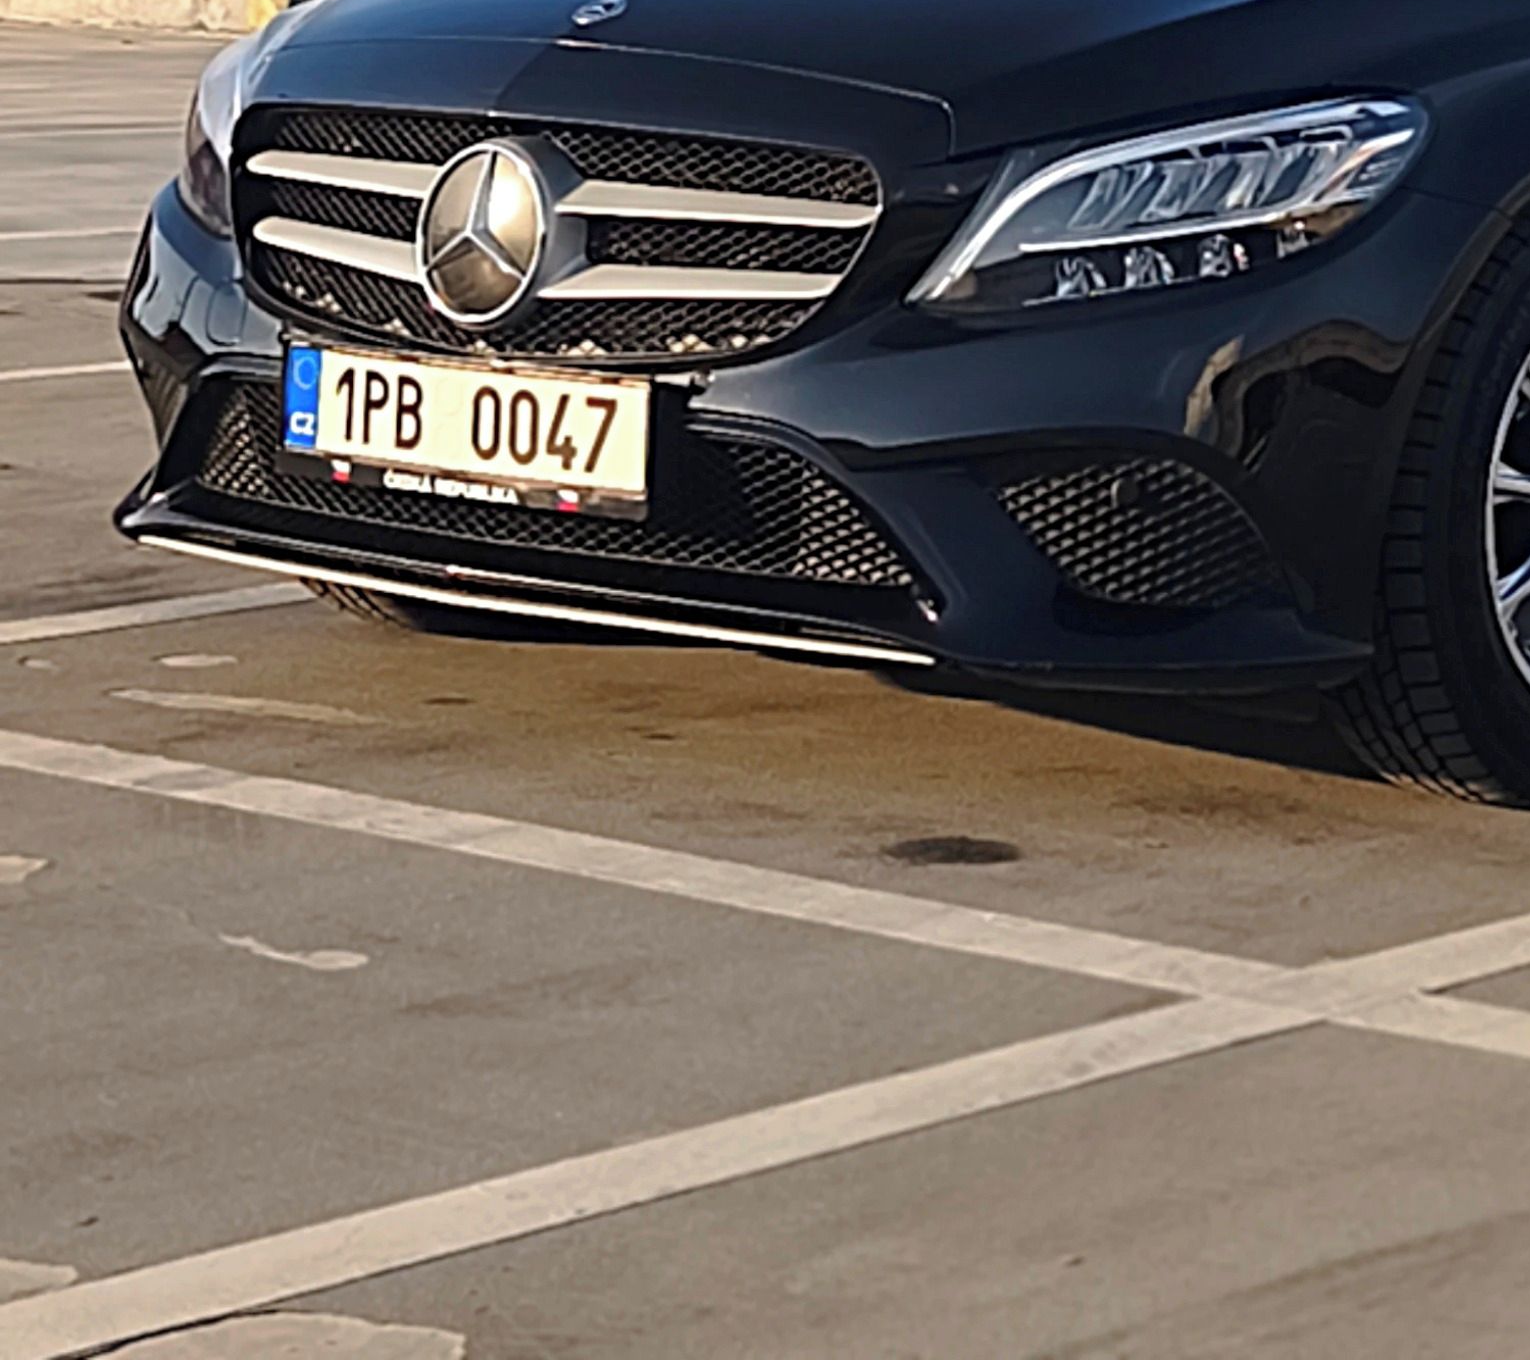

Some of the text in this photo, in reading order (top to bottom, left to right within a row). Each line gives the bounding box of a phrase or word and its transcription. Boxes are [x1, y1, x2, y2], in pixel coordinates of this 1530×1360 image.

[290, 411, 315, 435] CZ
[335, 368, 618, 474] 1PB 0047
